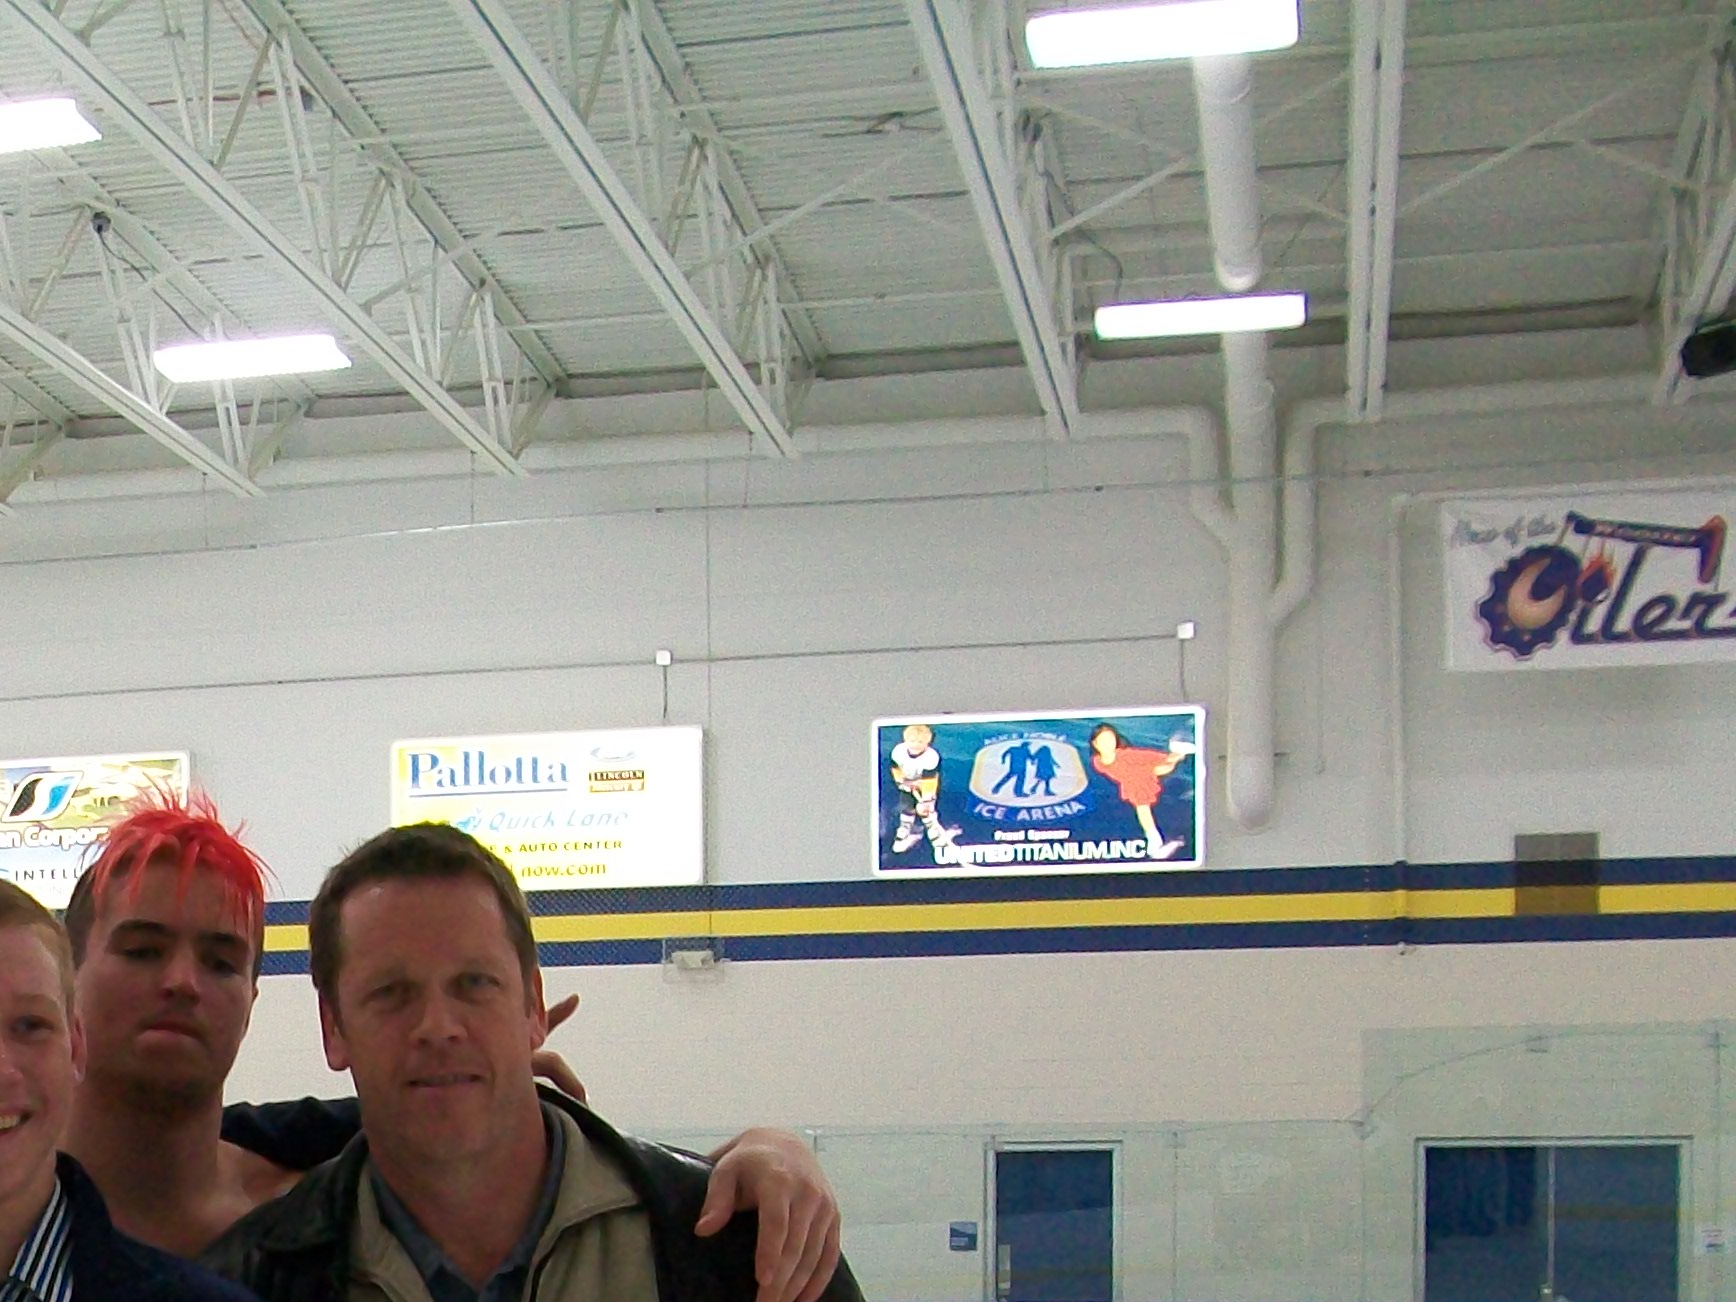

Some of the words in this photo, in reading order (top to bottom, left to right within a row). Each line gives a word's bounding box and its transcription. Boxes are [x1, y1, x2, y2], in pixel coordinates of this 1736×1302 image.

[1475, 543, 1736, 661] Oiler
[407, 750, 570, 790] Pallotta
[489, 809, 557, 832] Quick
[567, 809, 629, 827] Lane
[973, 802, 1006, 820] ICE
[1017, 800, 1087, 821] ARENA
[23, 825, 109, 851] Corpor
[519, 842, 558, 853] AUTO
[563, 840, 623, 852] CENTER
[15, 868, 79, 882] INTELL
